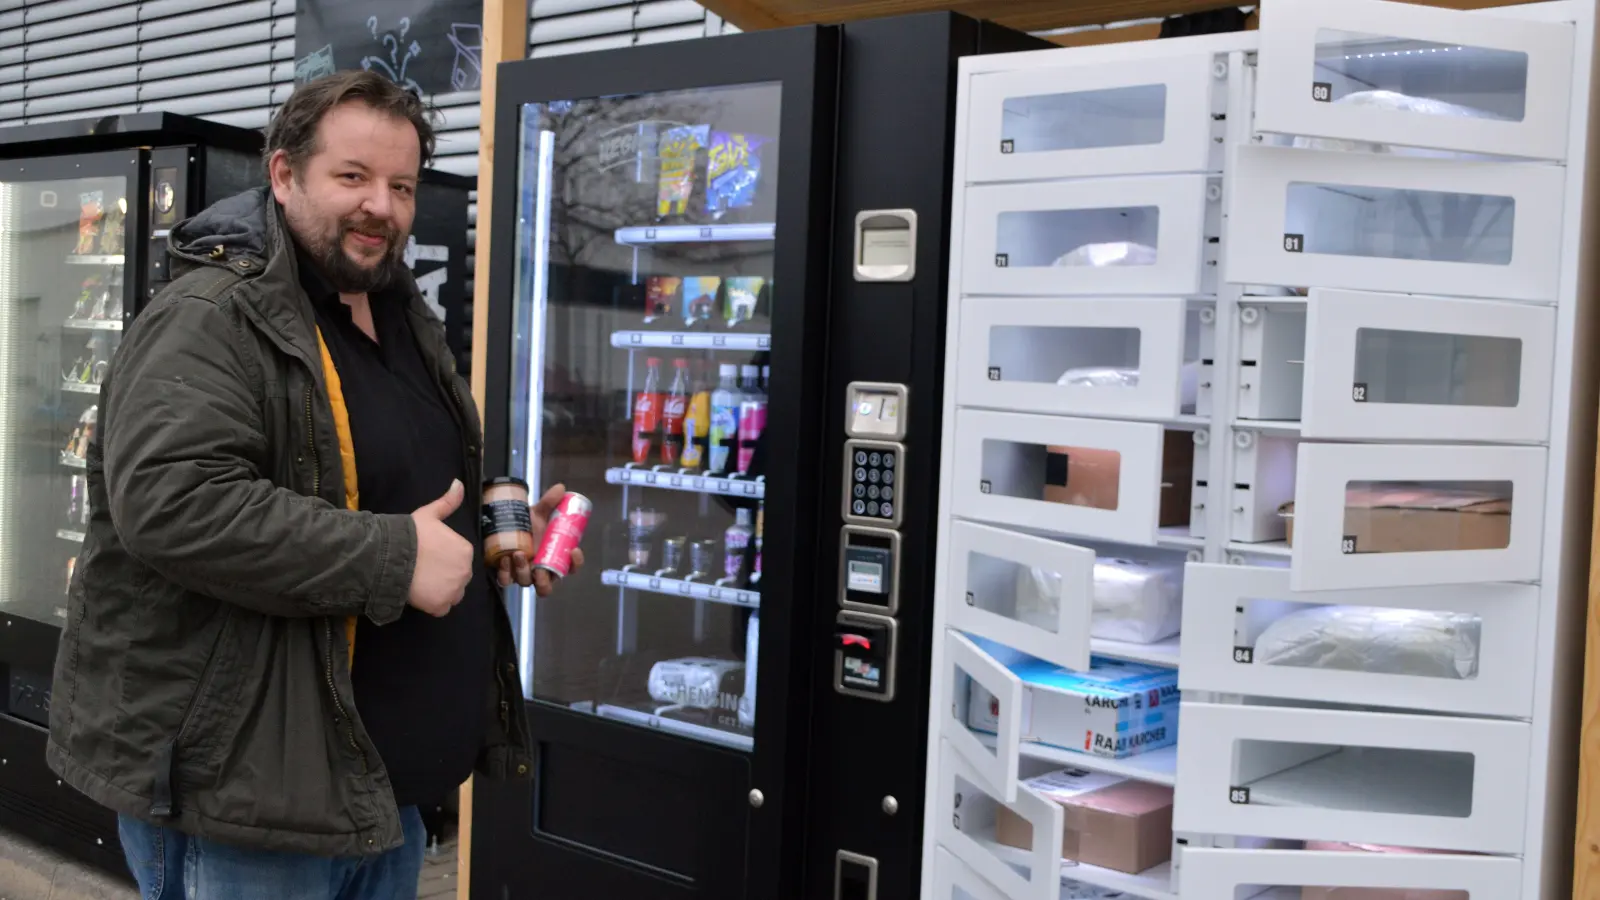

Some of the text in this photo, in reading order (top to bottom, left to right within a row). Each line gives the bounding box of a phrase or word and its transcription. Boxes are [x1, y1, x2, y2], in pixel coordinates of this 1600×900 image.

[1314, 86, 1328, 100] 80
[1285, 237, 1299, 250] 81
[1354, 387, 1365, 400] 82
[1342, 540, 1354, 553] 83
[1235, 649, 1249, 662] 84
[1129, 727, 1166, 747] KARCHER
[1231, 790, 1246, 803] 85
